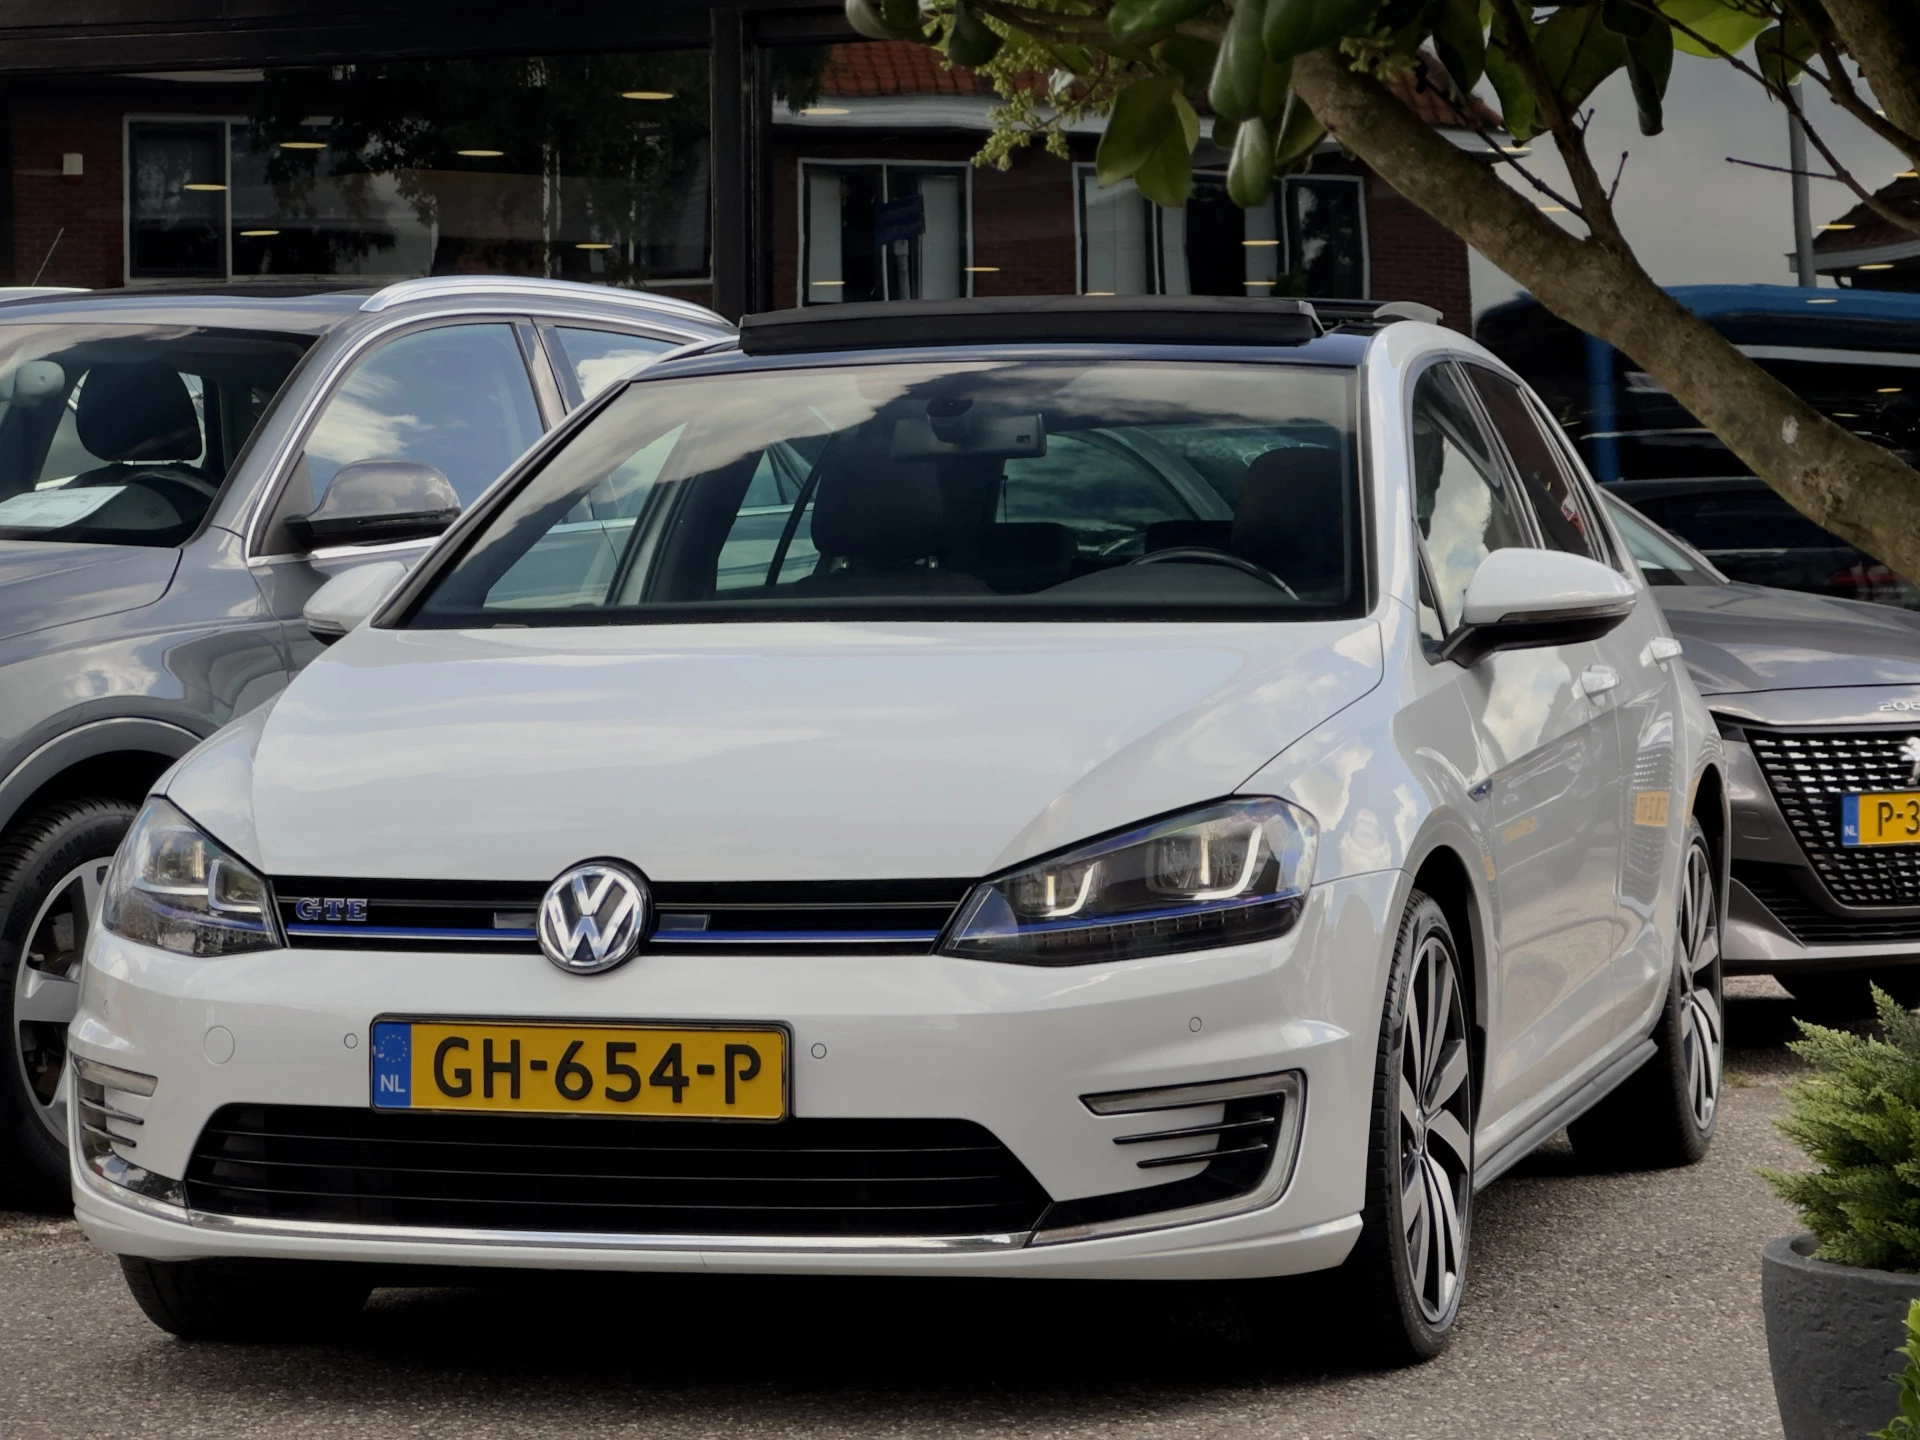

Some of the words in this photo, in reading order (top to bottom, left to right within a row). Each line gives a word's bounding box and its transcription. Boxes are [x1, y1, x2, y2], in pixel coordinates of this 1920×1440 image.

[1844, 825, 1858, 836] NL
[1878, 800, 1920, 837] P-3
[295, 897, 368, 922] GTE
[433, 1036, 762, 1104] GH-654-P
[380, 1073, 406, 1093] NL
